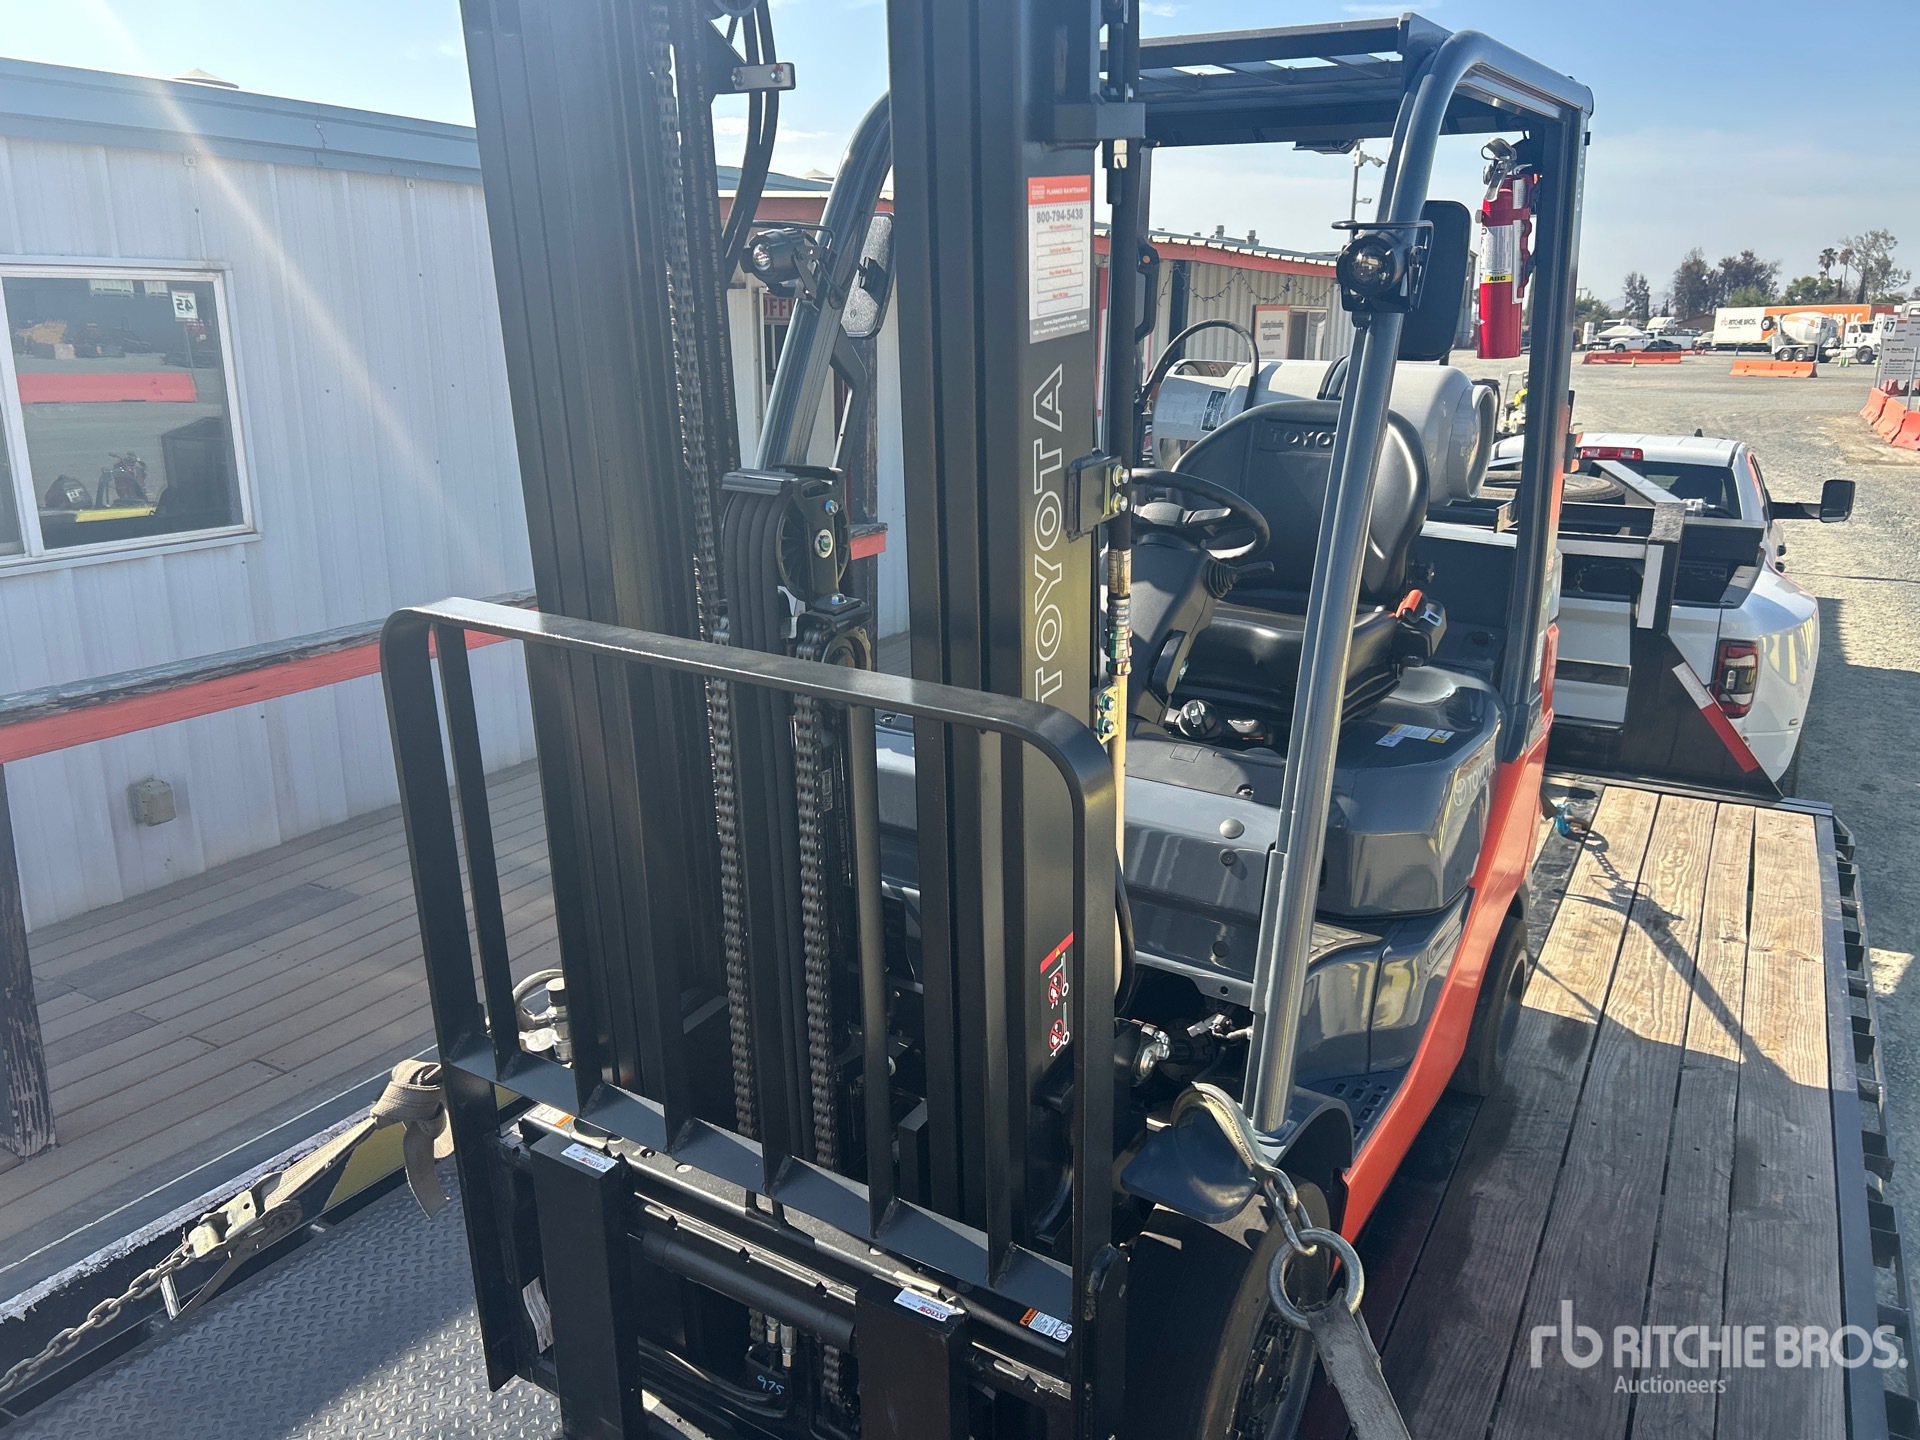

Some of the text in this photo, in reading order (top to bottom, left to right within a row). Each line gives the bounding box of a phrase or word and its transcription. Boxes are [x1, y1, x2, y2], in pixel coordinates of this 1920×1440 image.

[1036, 208, 1083, 224] 800-794-5438
[1884, 322, 1895, 332] 47
[1034, 364, 1063, 703] TOYOTA
[1466, 757, 1496, 794] TOYOTA
[917, 1306, 946, 1320] ARROW
[756, 1374, 785, 1396] 975
